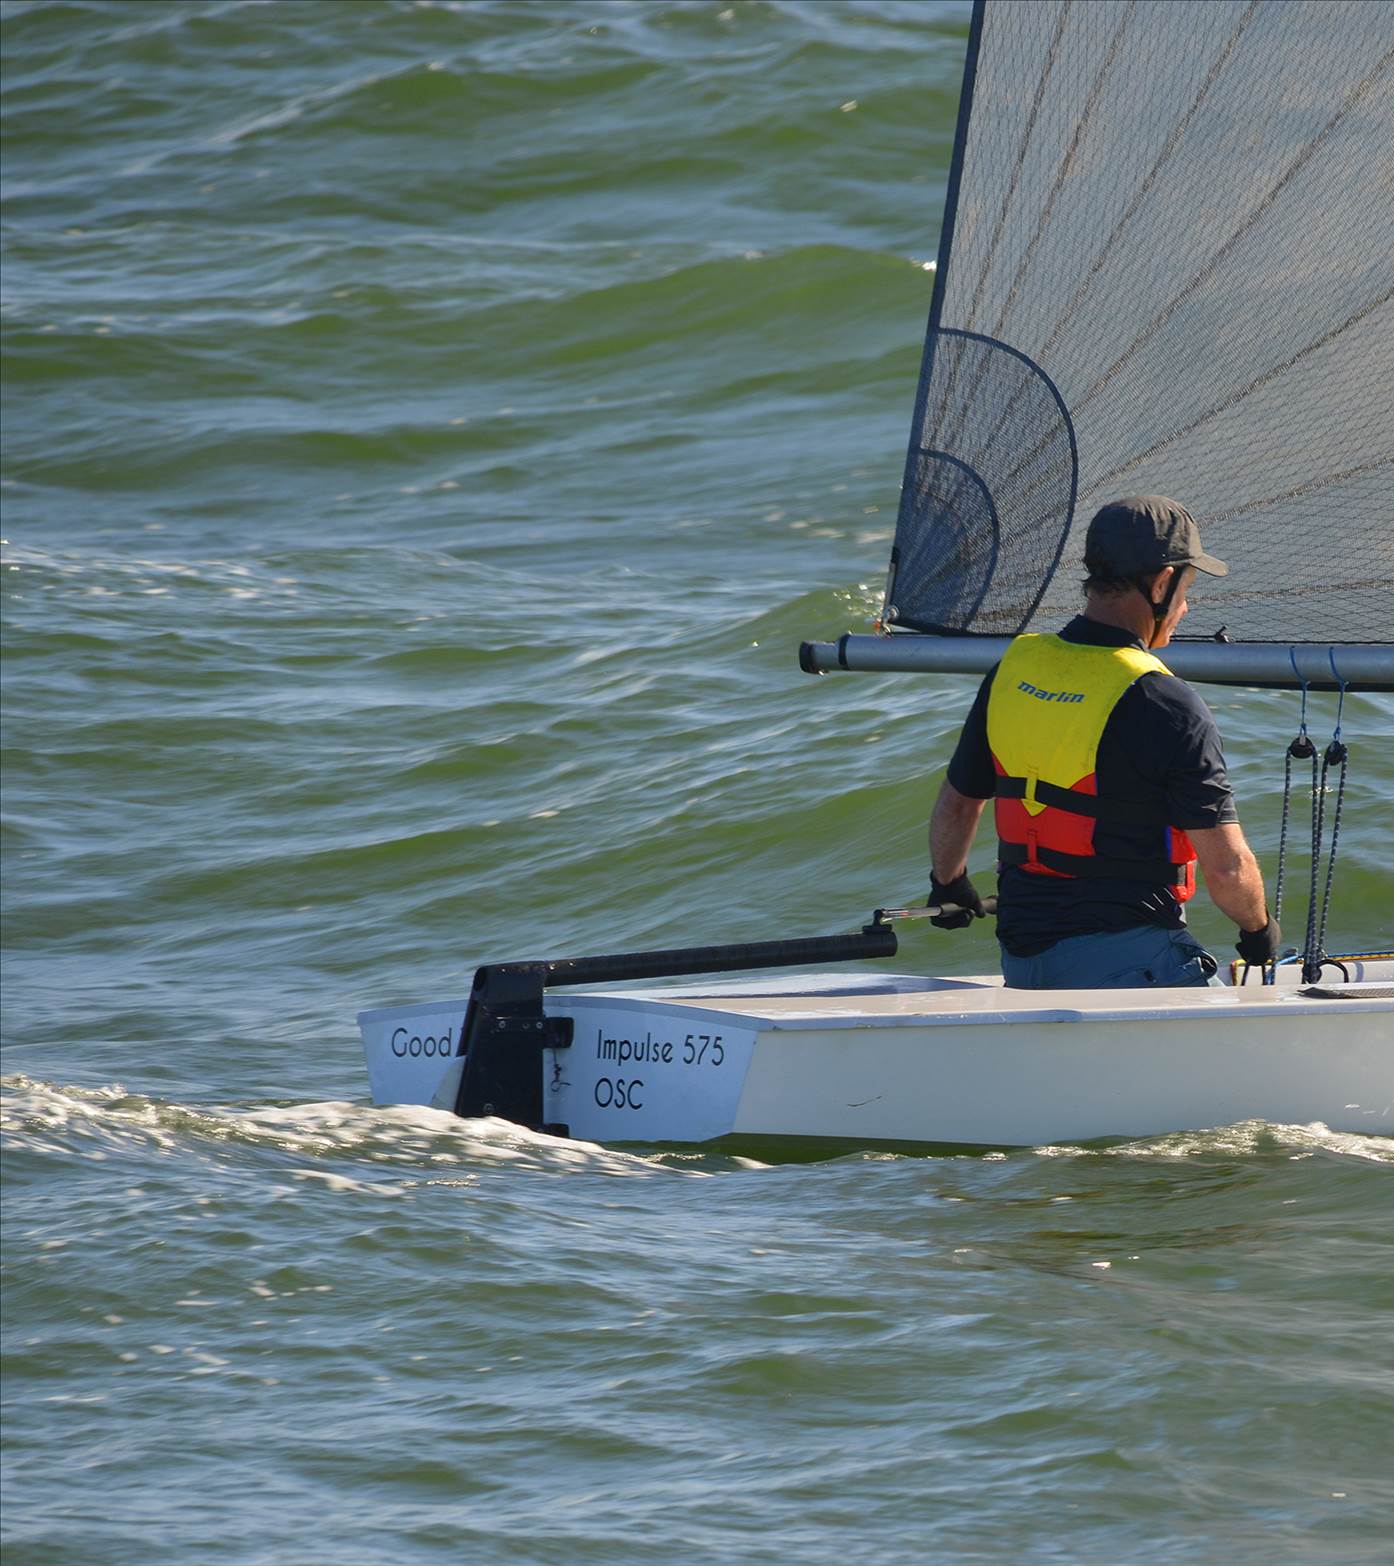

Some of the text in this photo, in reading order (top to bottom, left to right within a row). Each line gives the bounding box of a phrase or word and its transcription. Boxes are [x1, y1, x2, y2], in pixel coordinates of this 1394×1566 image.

[1017, 681, 1085, 703] marlin
[391, 1027, 452, 1057] Good
[596, 1029, 725, 1066] Impulse 575
[594, 1077, 644, 1110] OSC
